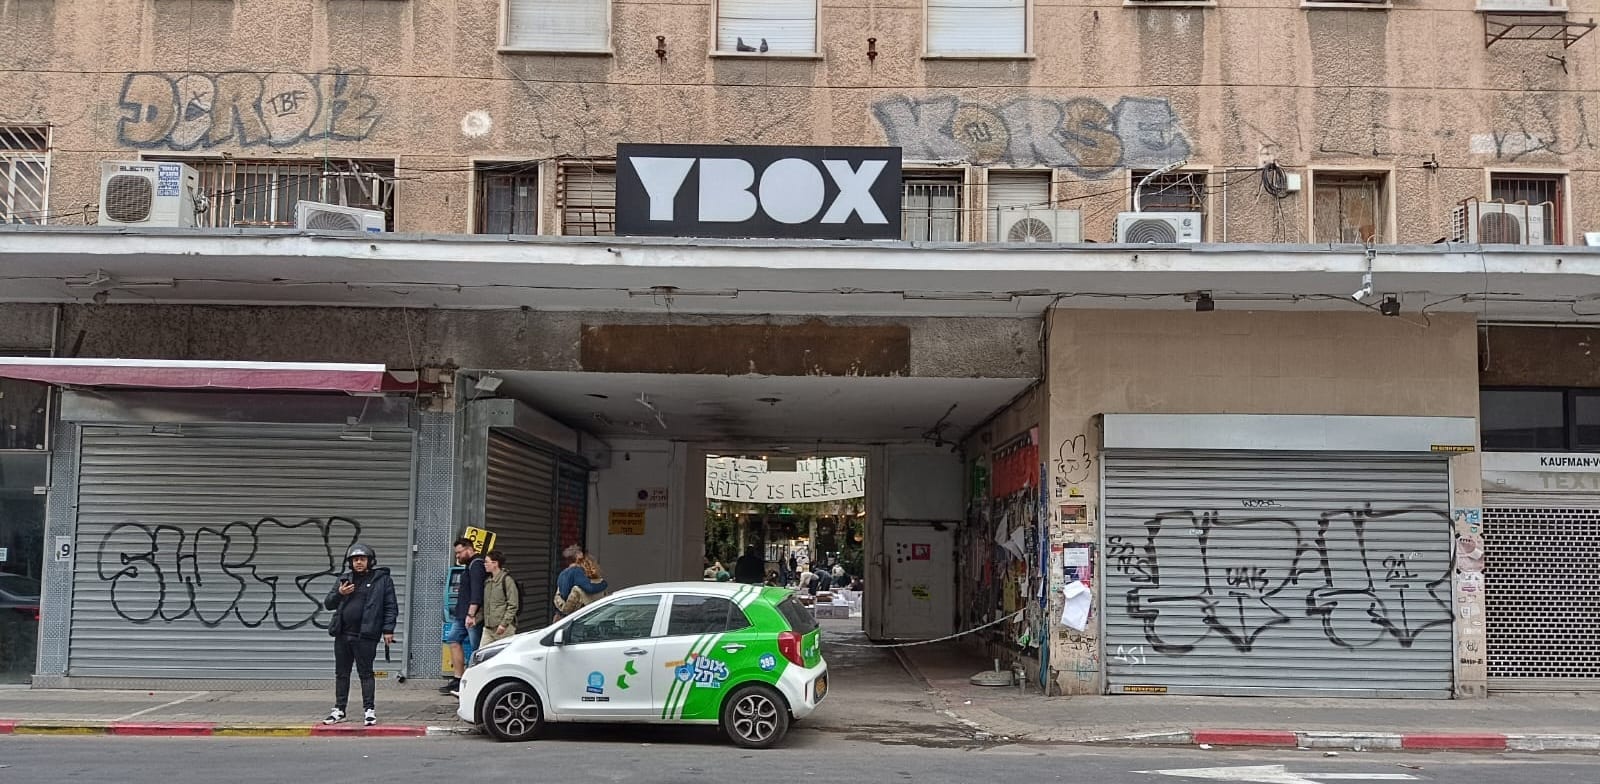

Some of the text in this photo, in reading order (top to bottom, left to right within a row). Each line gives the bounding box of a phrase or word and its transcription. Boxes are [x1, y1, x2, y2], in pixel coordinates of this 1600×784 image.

[629, 157, 889, 225] YBOX
[766, 484, 785, 499] IS
[61, 543, 71, 556] 9
